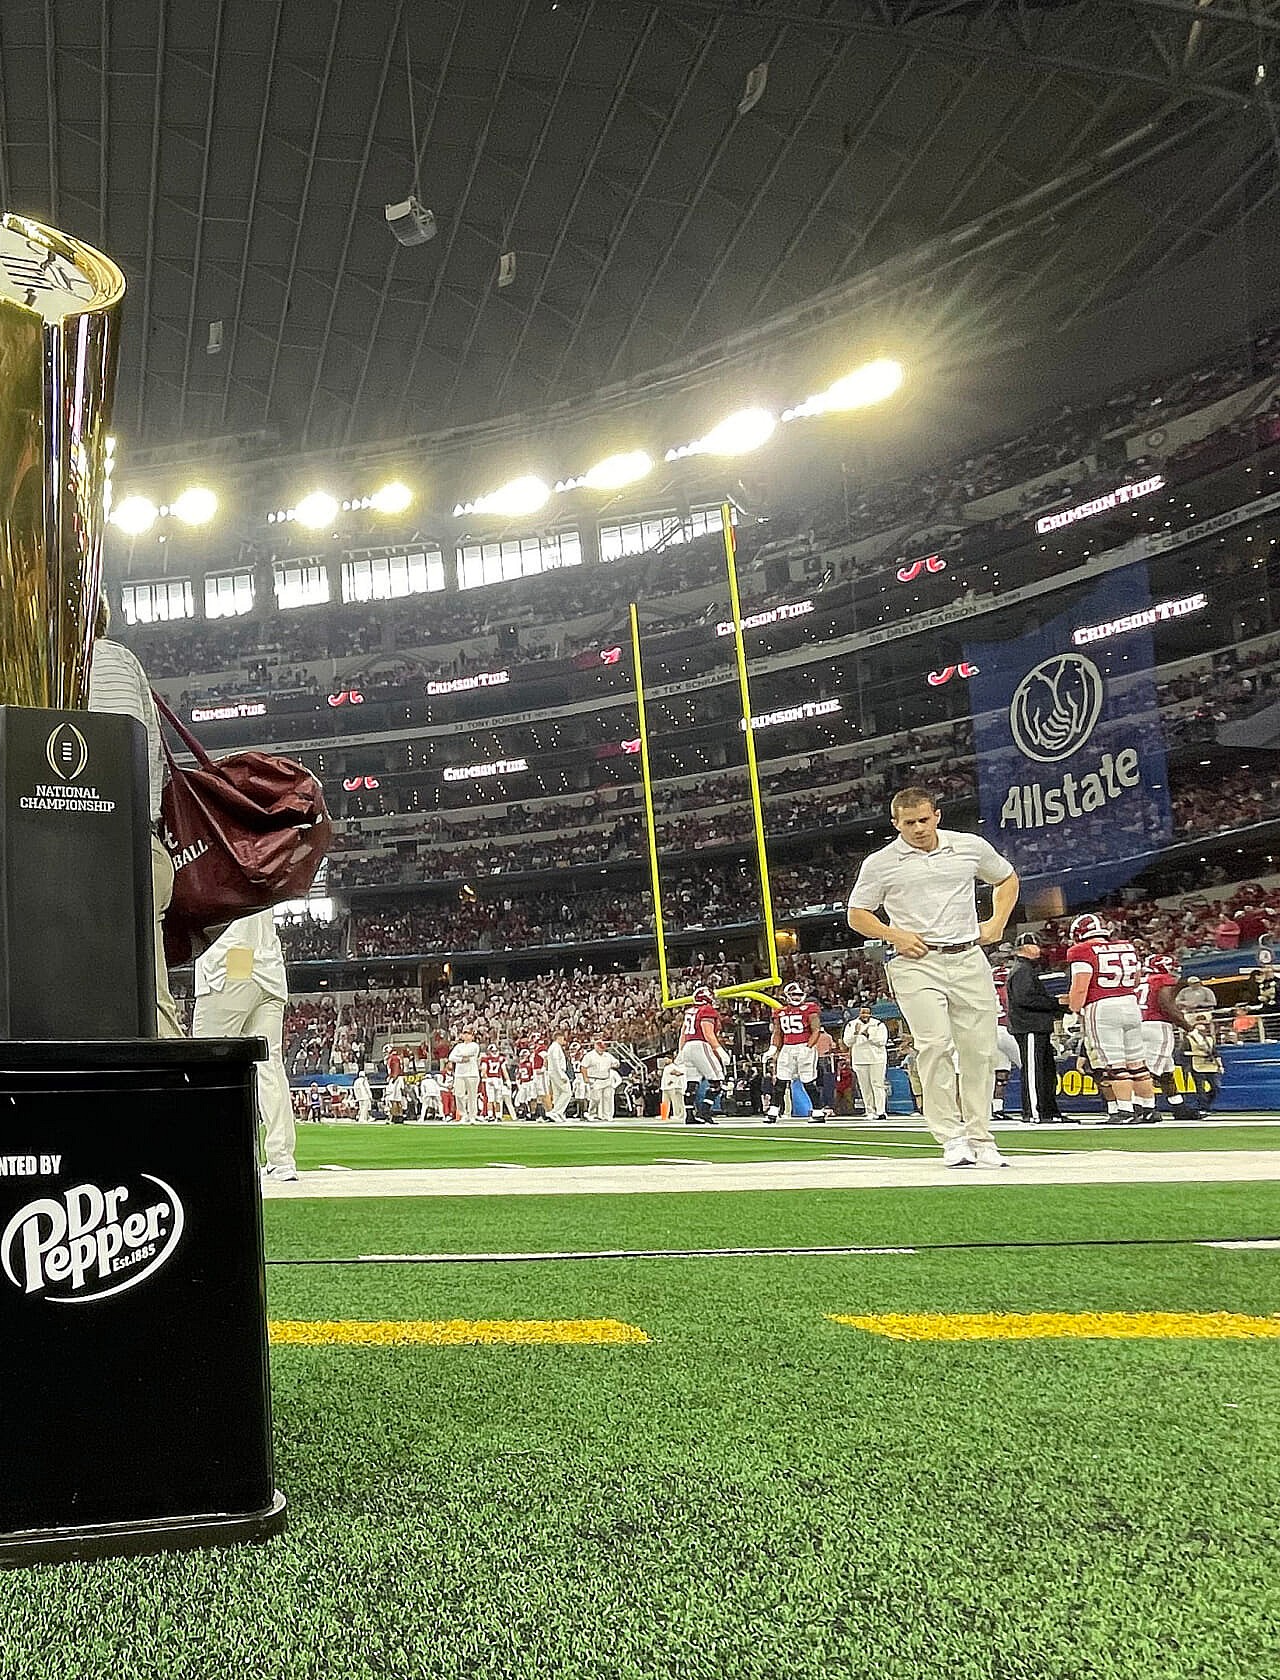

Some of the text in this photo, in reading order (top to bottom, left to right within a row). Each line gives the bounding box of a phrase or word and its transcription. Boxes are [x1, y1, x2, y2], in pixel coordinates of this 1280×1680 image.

[1036, 474, 1166, 535] CRIMSON TIDE
[716, 600, 815, 637] CRMSON TIDE
[920, 606, 977, 629] PEARSON
[1073, 593, 1209, 645] CRIMSON TIDE
[426, 670, 510, 696] CRIMSON TIDE
[191, 707, 239, 722] CRIMSON
[443, 763, 497, 782] CRIMSON
[36, 785, 100, 799] NATIONAL
[1000, 748, 1140, 829] Allstate
[20, 797, 115, 812] CHAMPIONSHIP
[172, 840, 209, 872] BALL
[780, 1014, 804, 1034] 85
[39, 1155, 62, 1175] BY
[63, 1183, 129, 1240] Dr
